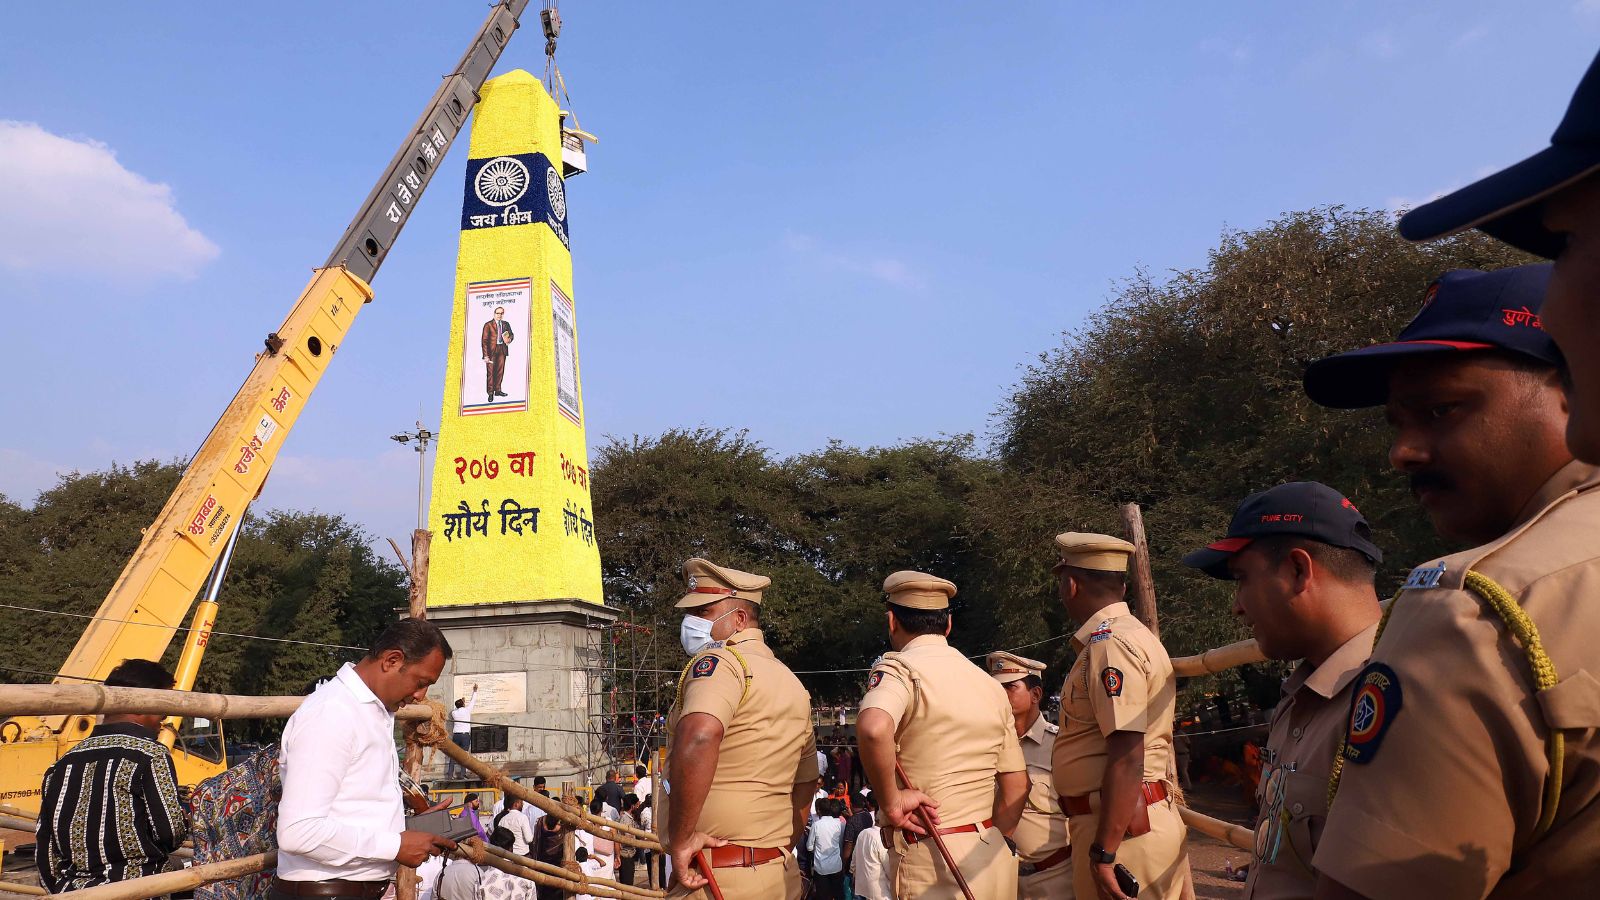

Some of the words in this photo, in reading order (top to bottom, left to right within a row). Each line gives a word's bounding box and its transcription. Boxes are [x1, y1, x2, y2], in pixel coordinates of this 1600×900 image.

[385, 169, 421, 223] राजेश
[470, 213, 498, 227] जय
[234, 435, 264, 474] राजेश
[270, 386, 292, 413] क्रेन
[454, 455, 499, 484] २०७
[507, 452, 536, 477] वा
[560, 453, 576, 485] २०७
[577, 465, 587, 491] वा
[188, 494, 217, 535] भुजबळ
[442, 499, 491, 542] शौर्य
[498, 498, 540, 536] दिन
[1283, 514, 1303, 523] CITY
[0, 788, 42, 800] MS750B-M
